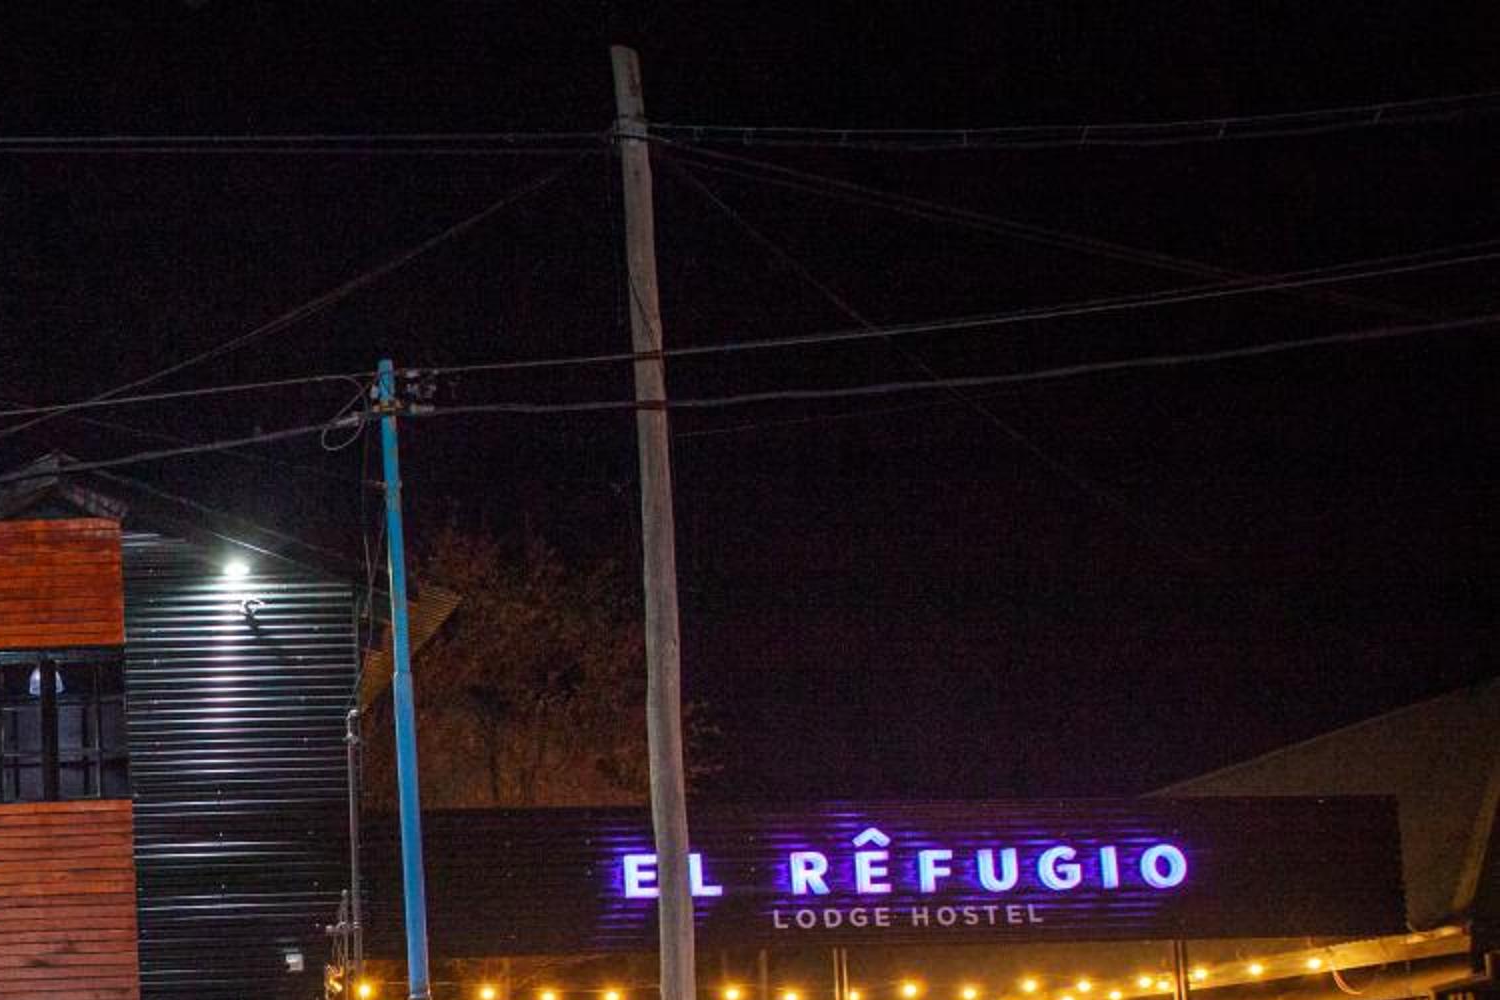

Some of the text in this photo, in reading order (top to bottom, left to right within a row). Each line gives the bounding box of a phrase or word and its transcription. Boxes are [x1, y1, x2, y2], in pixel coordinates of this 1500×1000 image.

[623, 827, 1188, 898] EL RÊFUGIO
[773, 903, 1044, 930] LODGE HOSTEL
